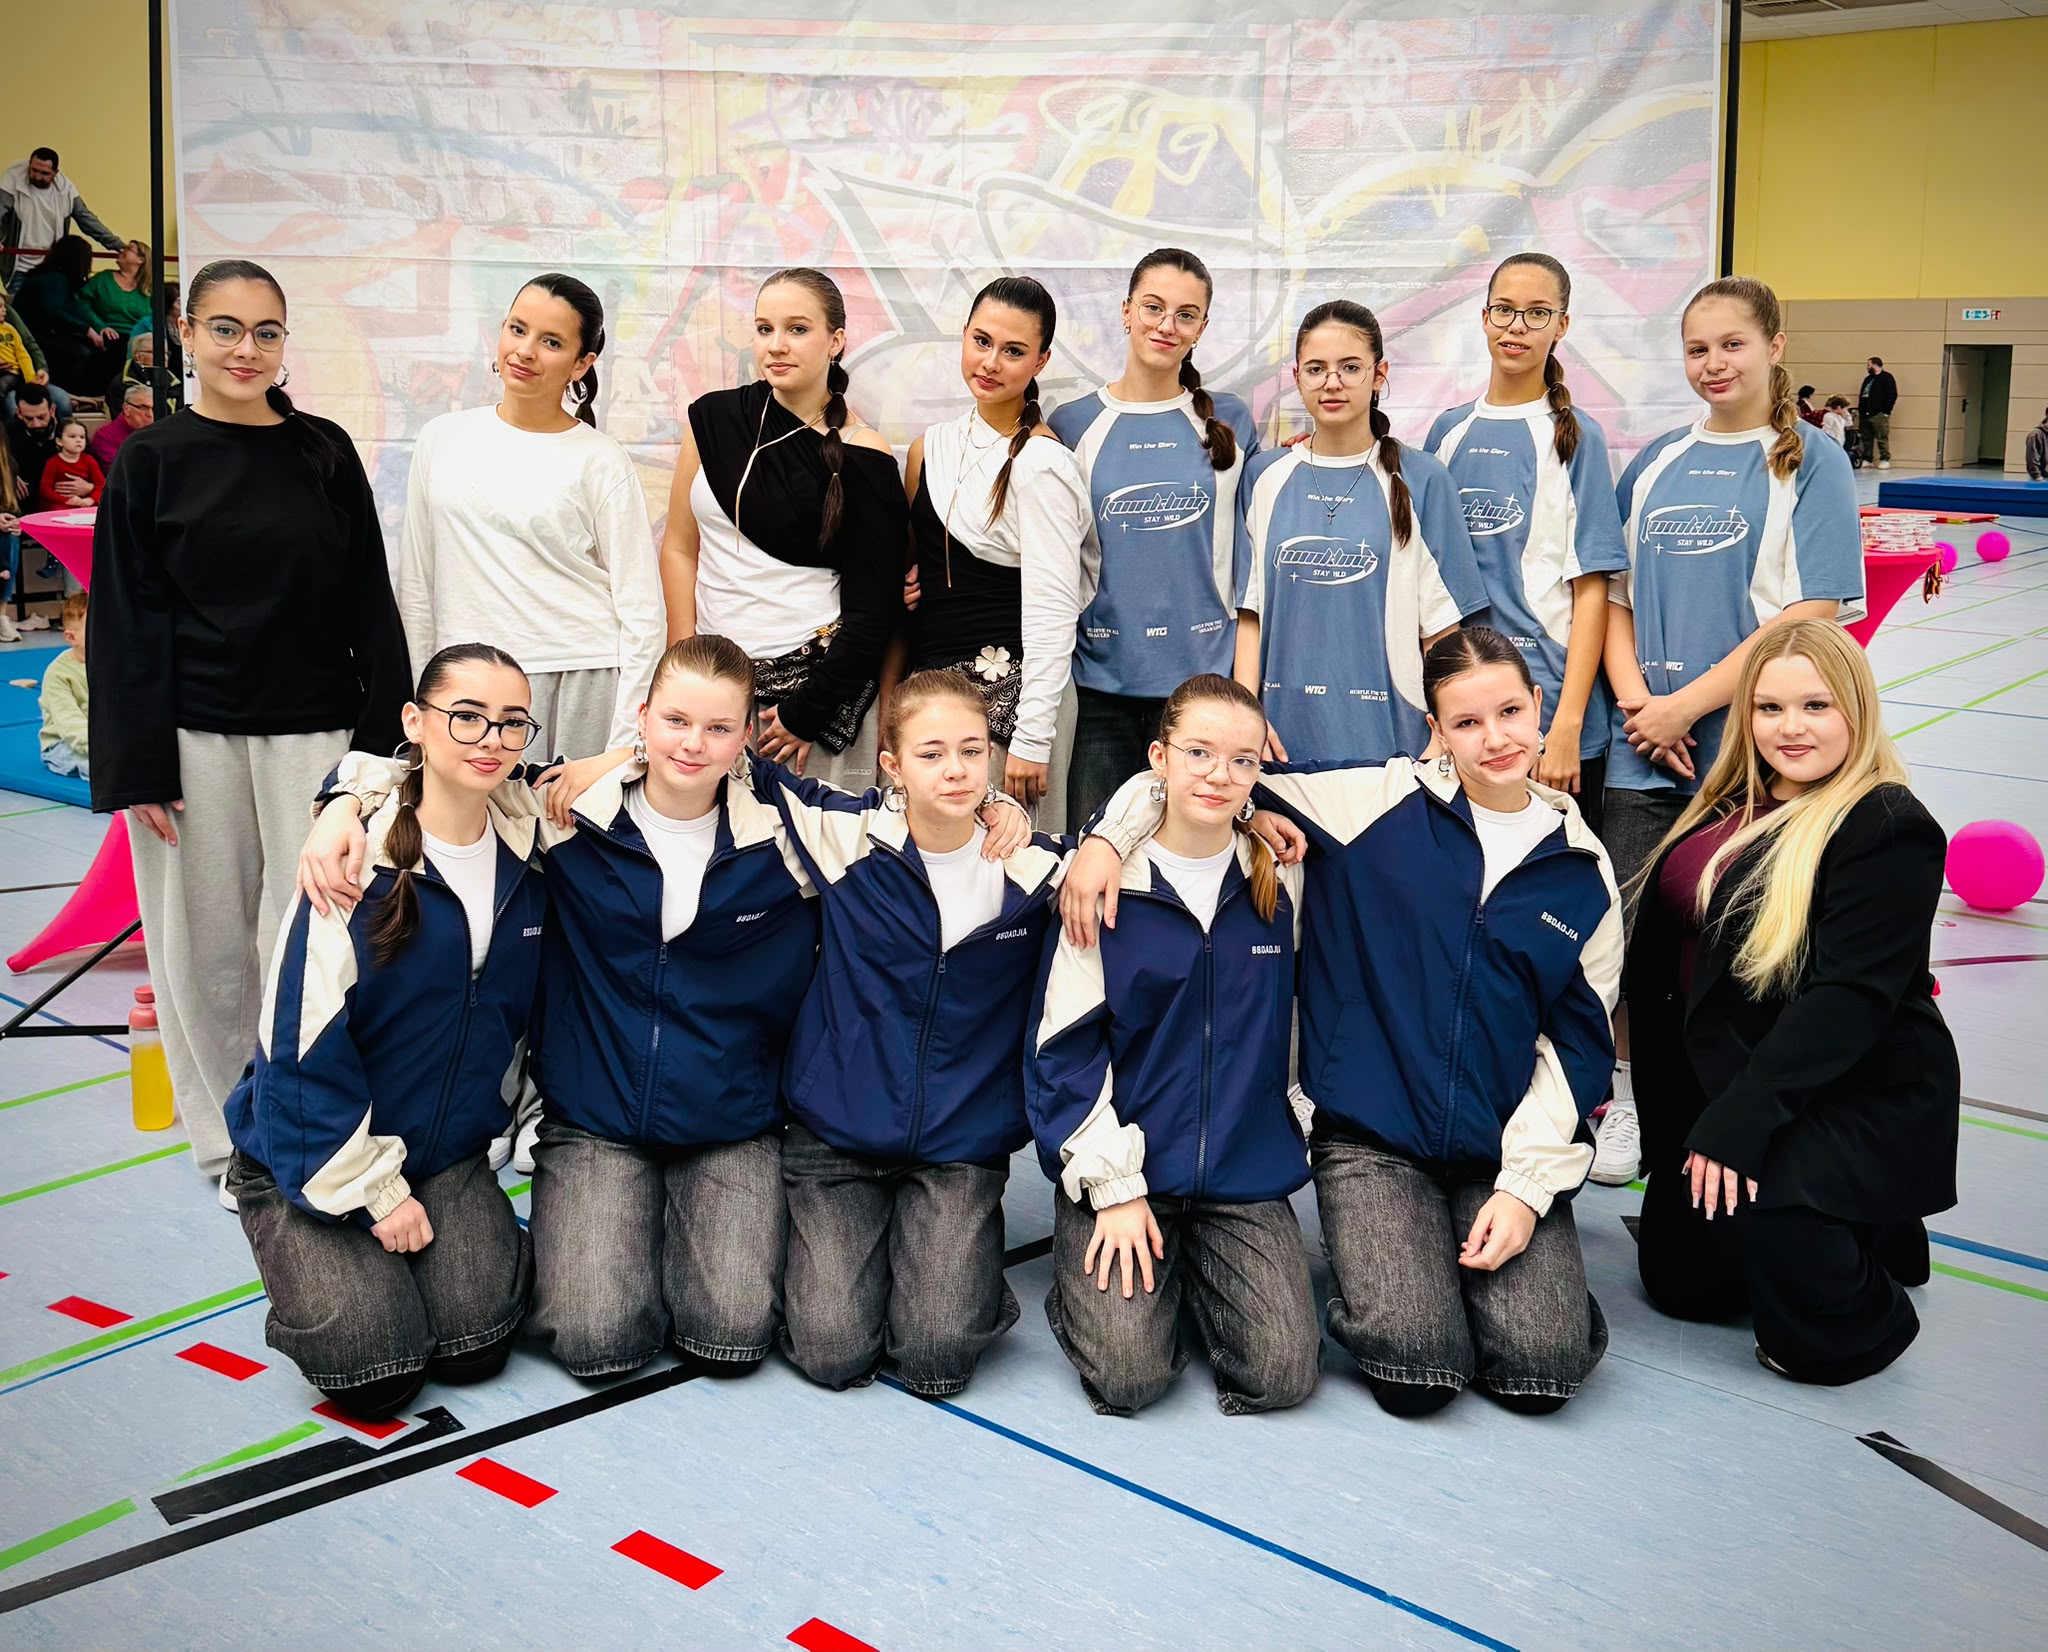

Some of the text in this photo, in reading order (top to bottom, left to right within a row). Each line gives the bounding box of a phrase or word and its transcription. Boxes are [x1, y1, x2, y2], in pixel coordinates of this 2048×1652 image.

[1158, 441, 1177, 449] Glory
[1490, 447, 1510, 457] Glory
[1144, 514, 1180, 524] STAY WILD
[1478, 521, 1494, 529] WILD
[1676, 539, 1694, 547] STAY
[1313, 569, 1330, 577] STAY
